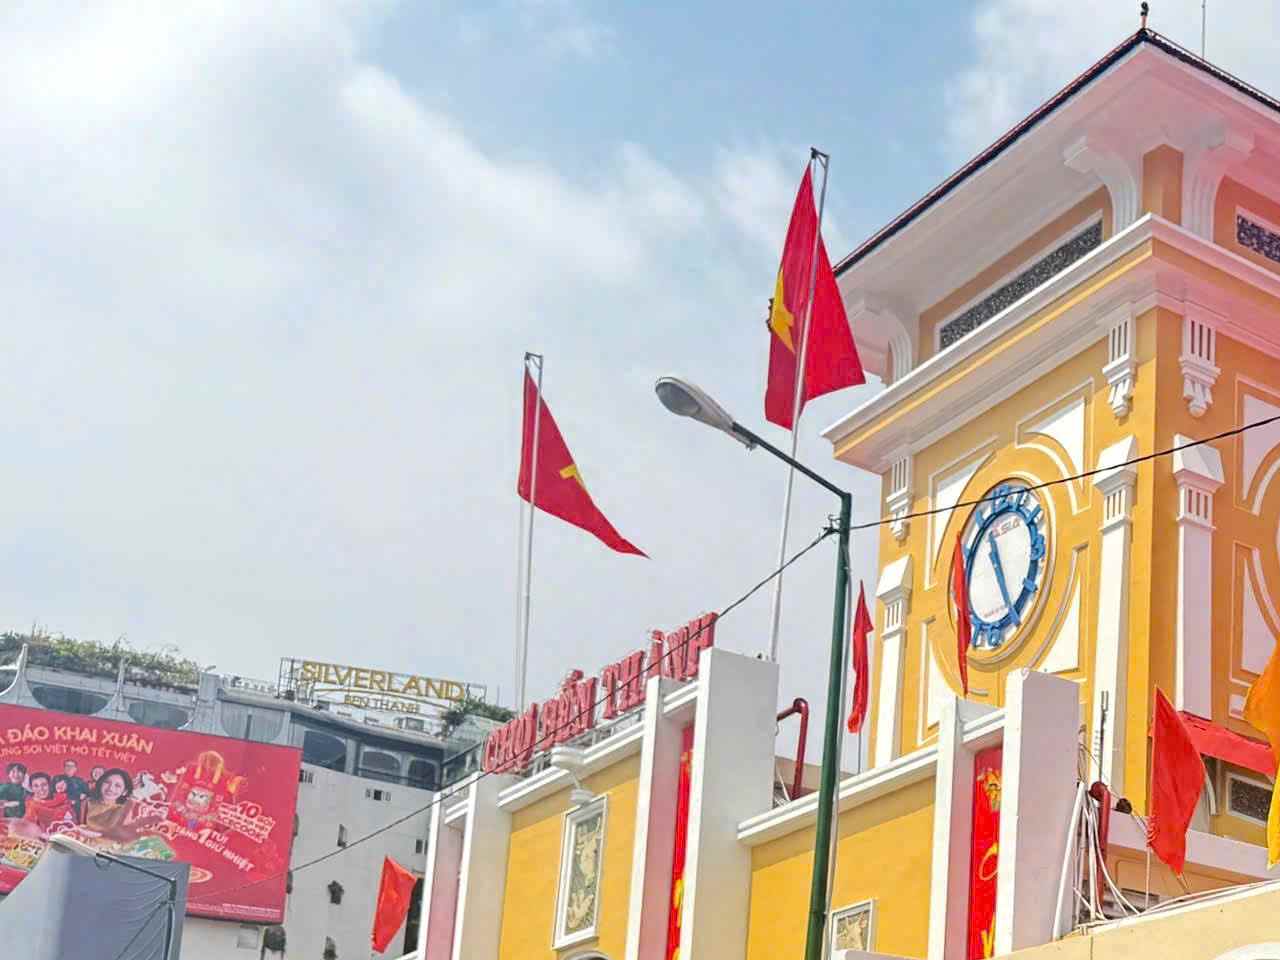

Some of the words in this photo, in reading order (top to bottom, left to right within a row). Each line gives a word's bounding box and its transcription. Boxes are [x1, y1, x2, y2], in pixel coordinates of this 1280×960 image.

[302, 660, 466, 702] SILVERLAND
[54, 726, 97, 743] KHAI
[102, 730, 154, 754] XUÂN
